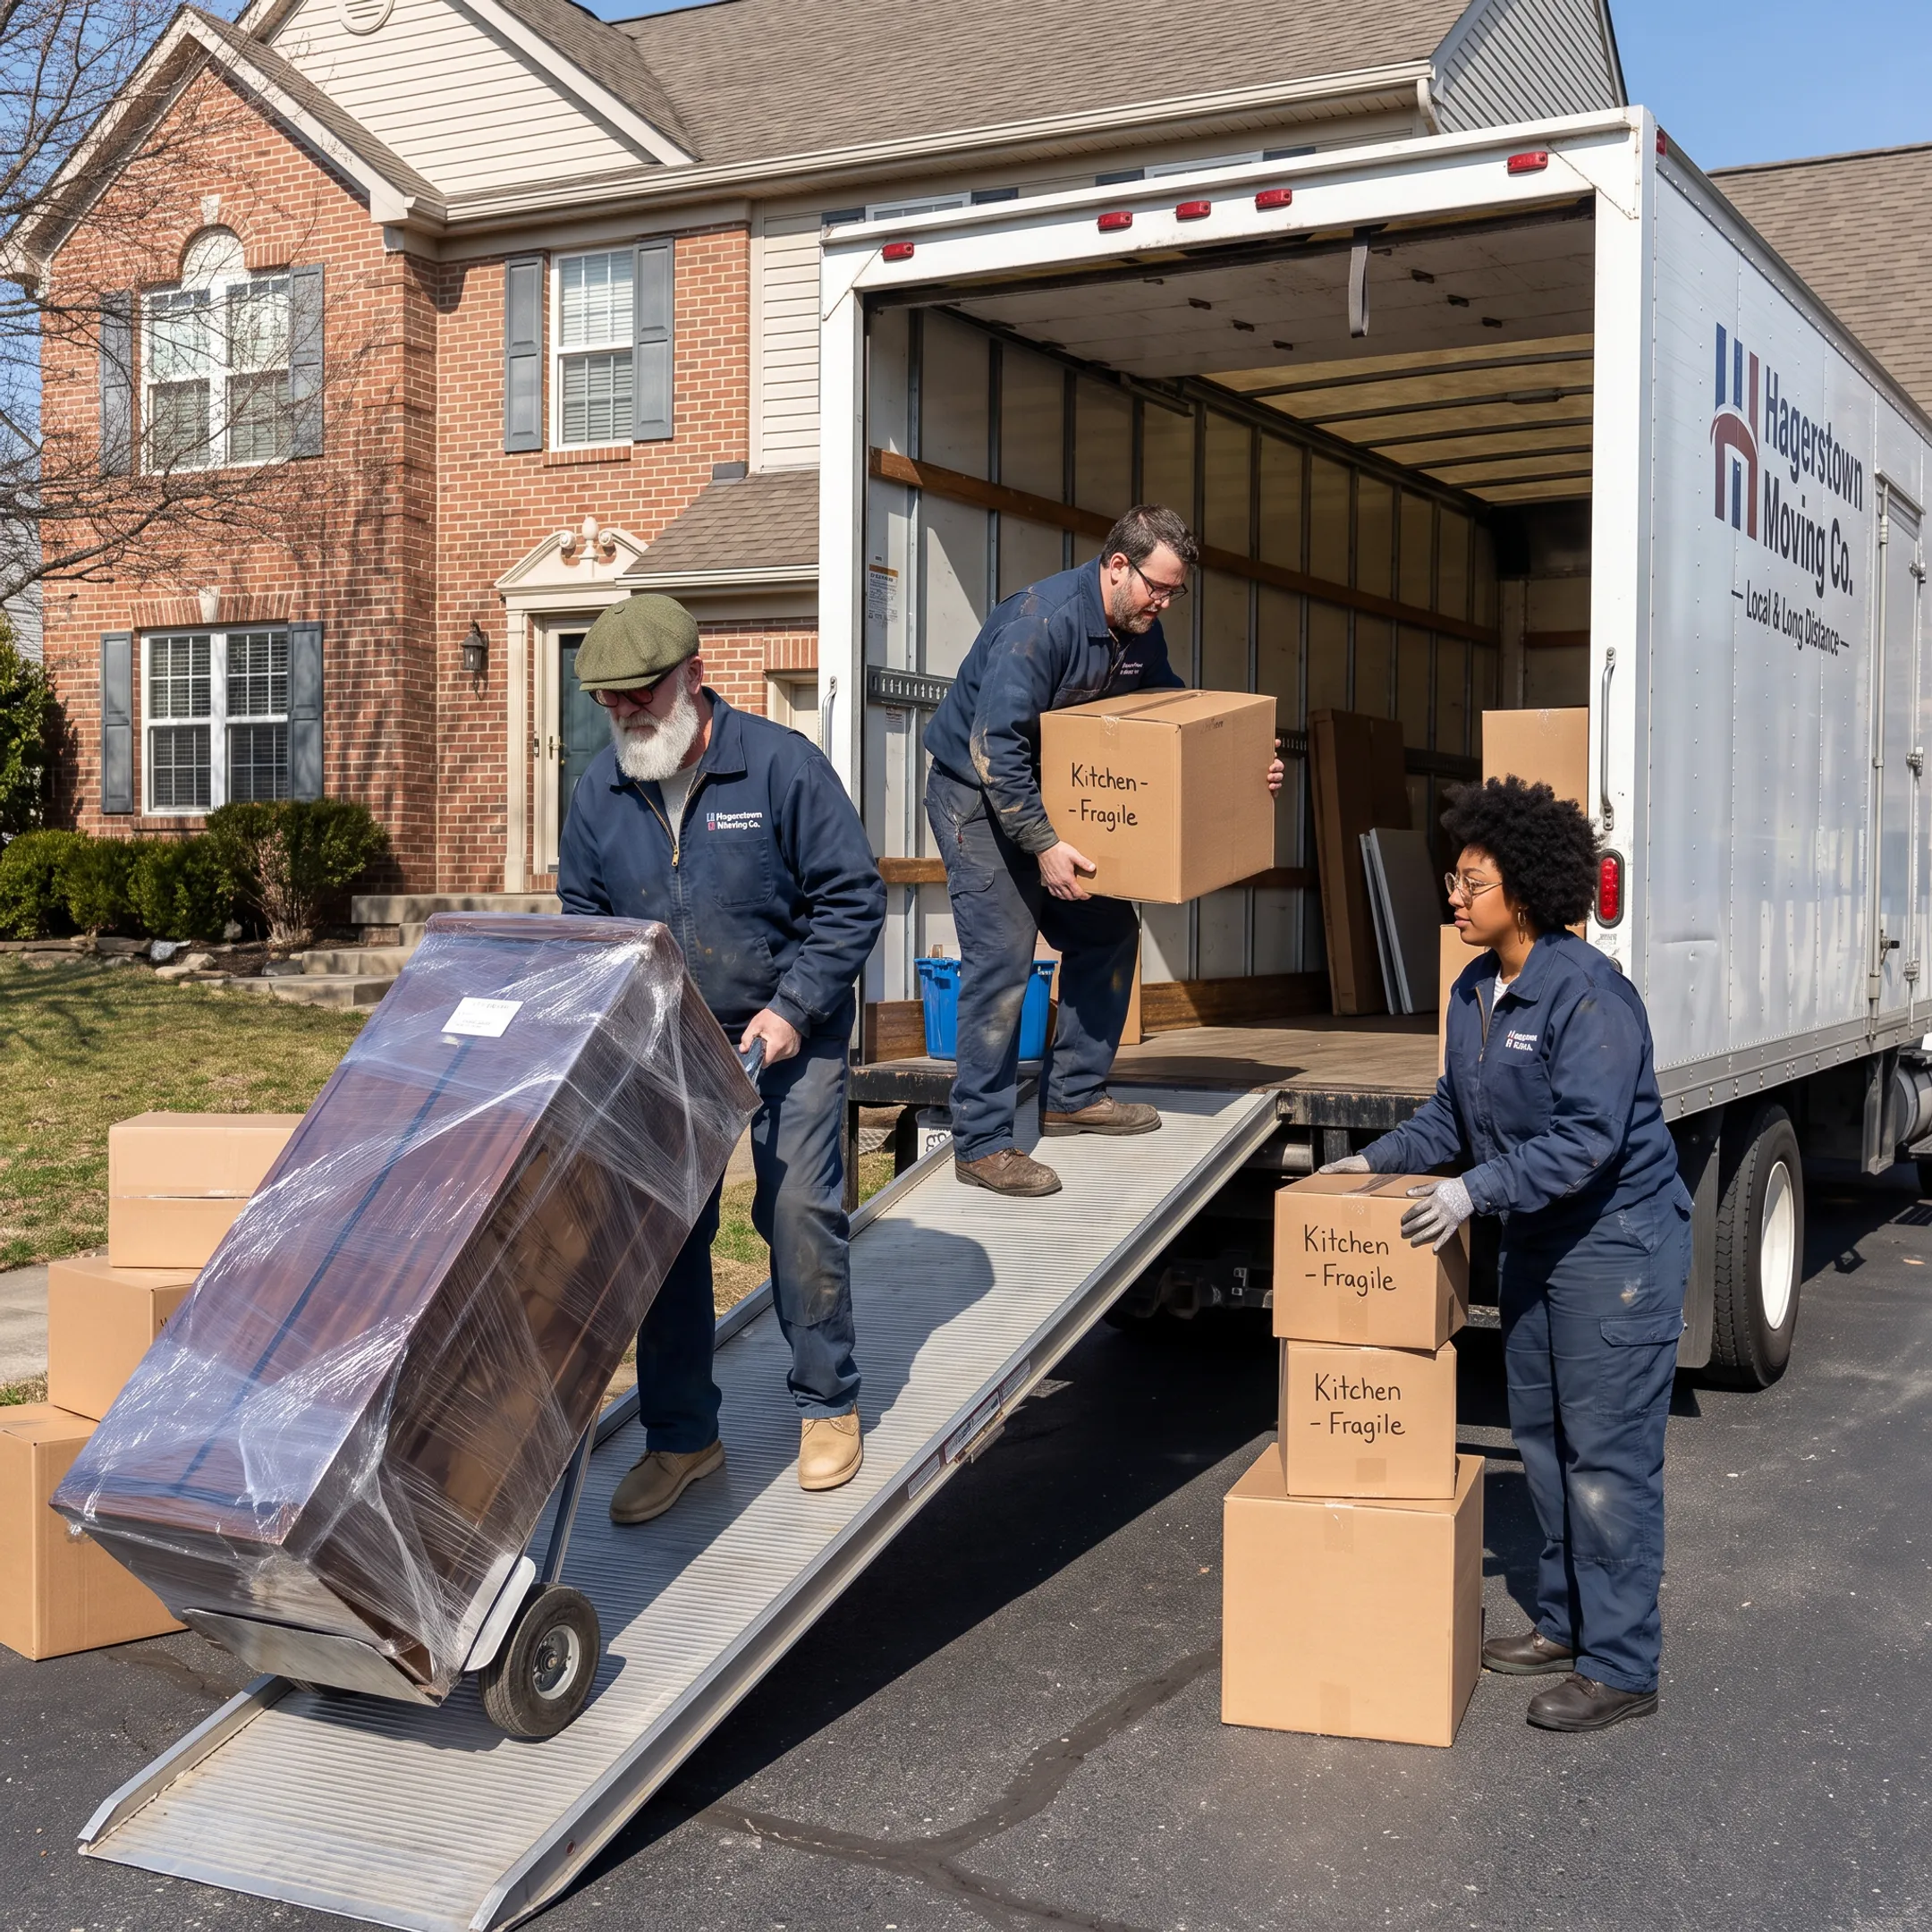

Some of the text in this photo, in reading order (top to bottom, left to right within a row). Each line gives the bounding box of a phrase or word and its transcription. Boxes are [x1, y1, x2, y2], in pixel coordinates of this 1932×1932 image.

[1765, 365, 1863, 512] Hagerstown
[1763, 469, 1853, 599] Moving Co.
[1746, 579, 1771, 627] Local
[1772, 591, 1781, 631] &
[1782, 597, 1803, 651] Long
[749, 820, 760, 828] Co.
[1304, 1224, 1389, 1255] Kitchen
[1315, 1372, 1402, 1402] Kitchen
